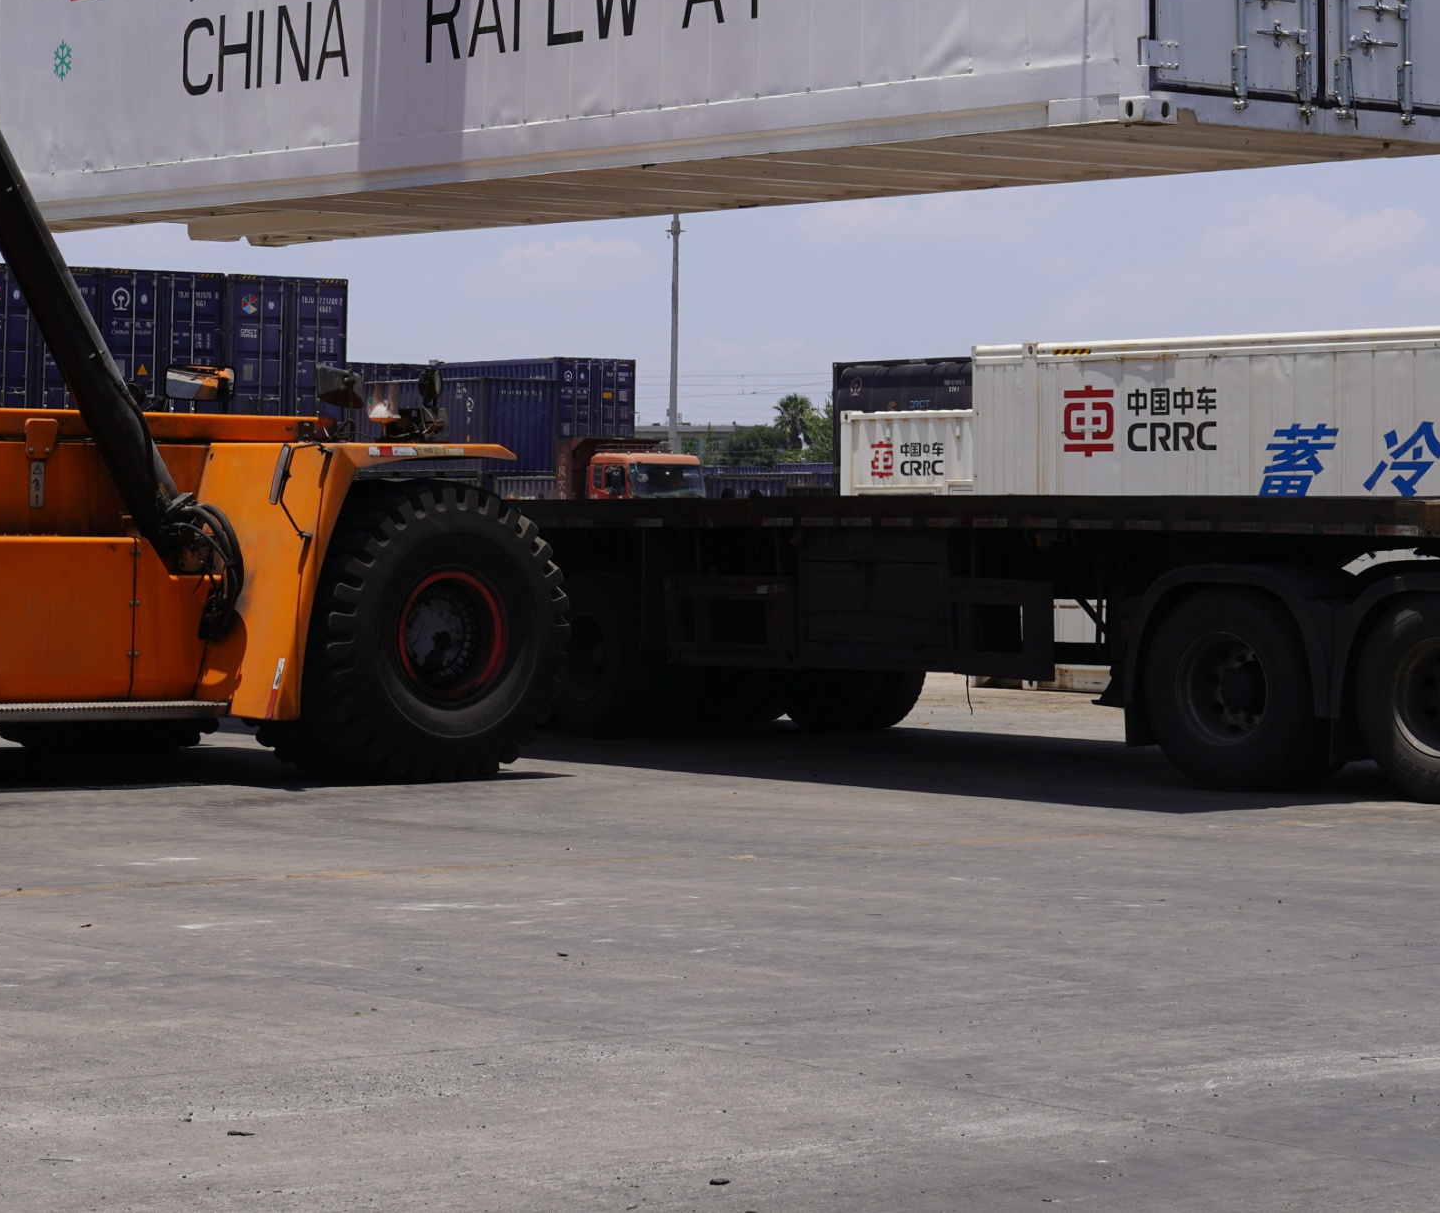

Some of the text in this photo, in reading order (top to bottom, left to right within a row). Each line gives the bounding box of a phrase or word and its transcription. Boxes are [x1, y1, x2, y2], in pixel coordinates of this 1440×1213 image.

[1127, 387, 1217, 416] 中国中车
[1127, 421, 1217, 452] CRRC
[900, 442, 944, 457] 中国中车
[900, 460, 944, 476] CRRC
